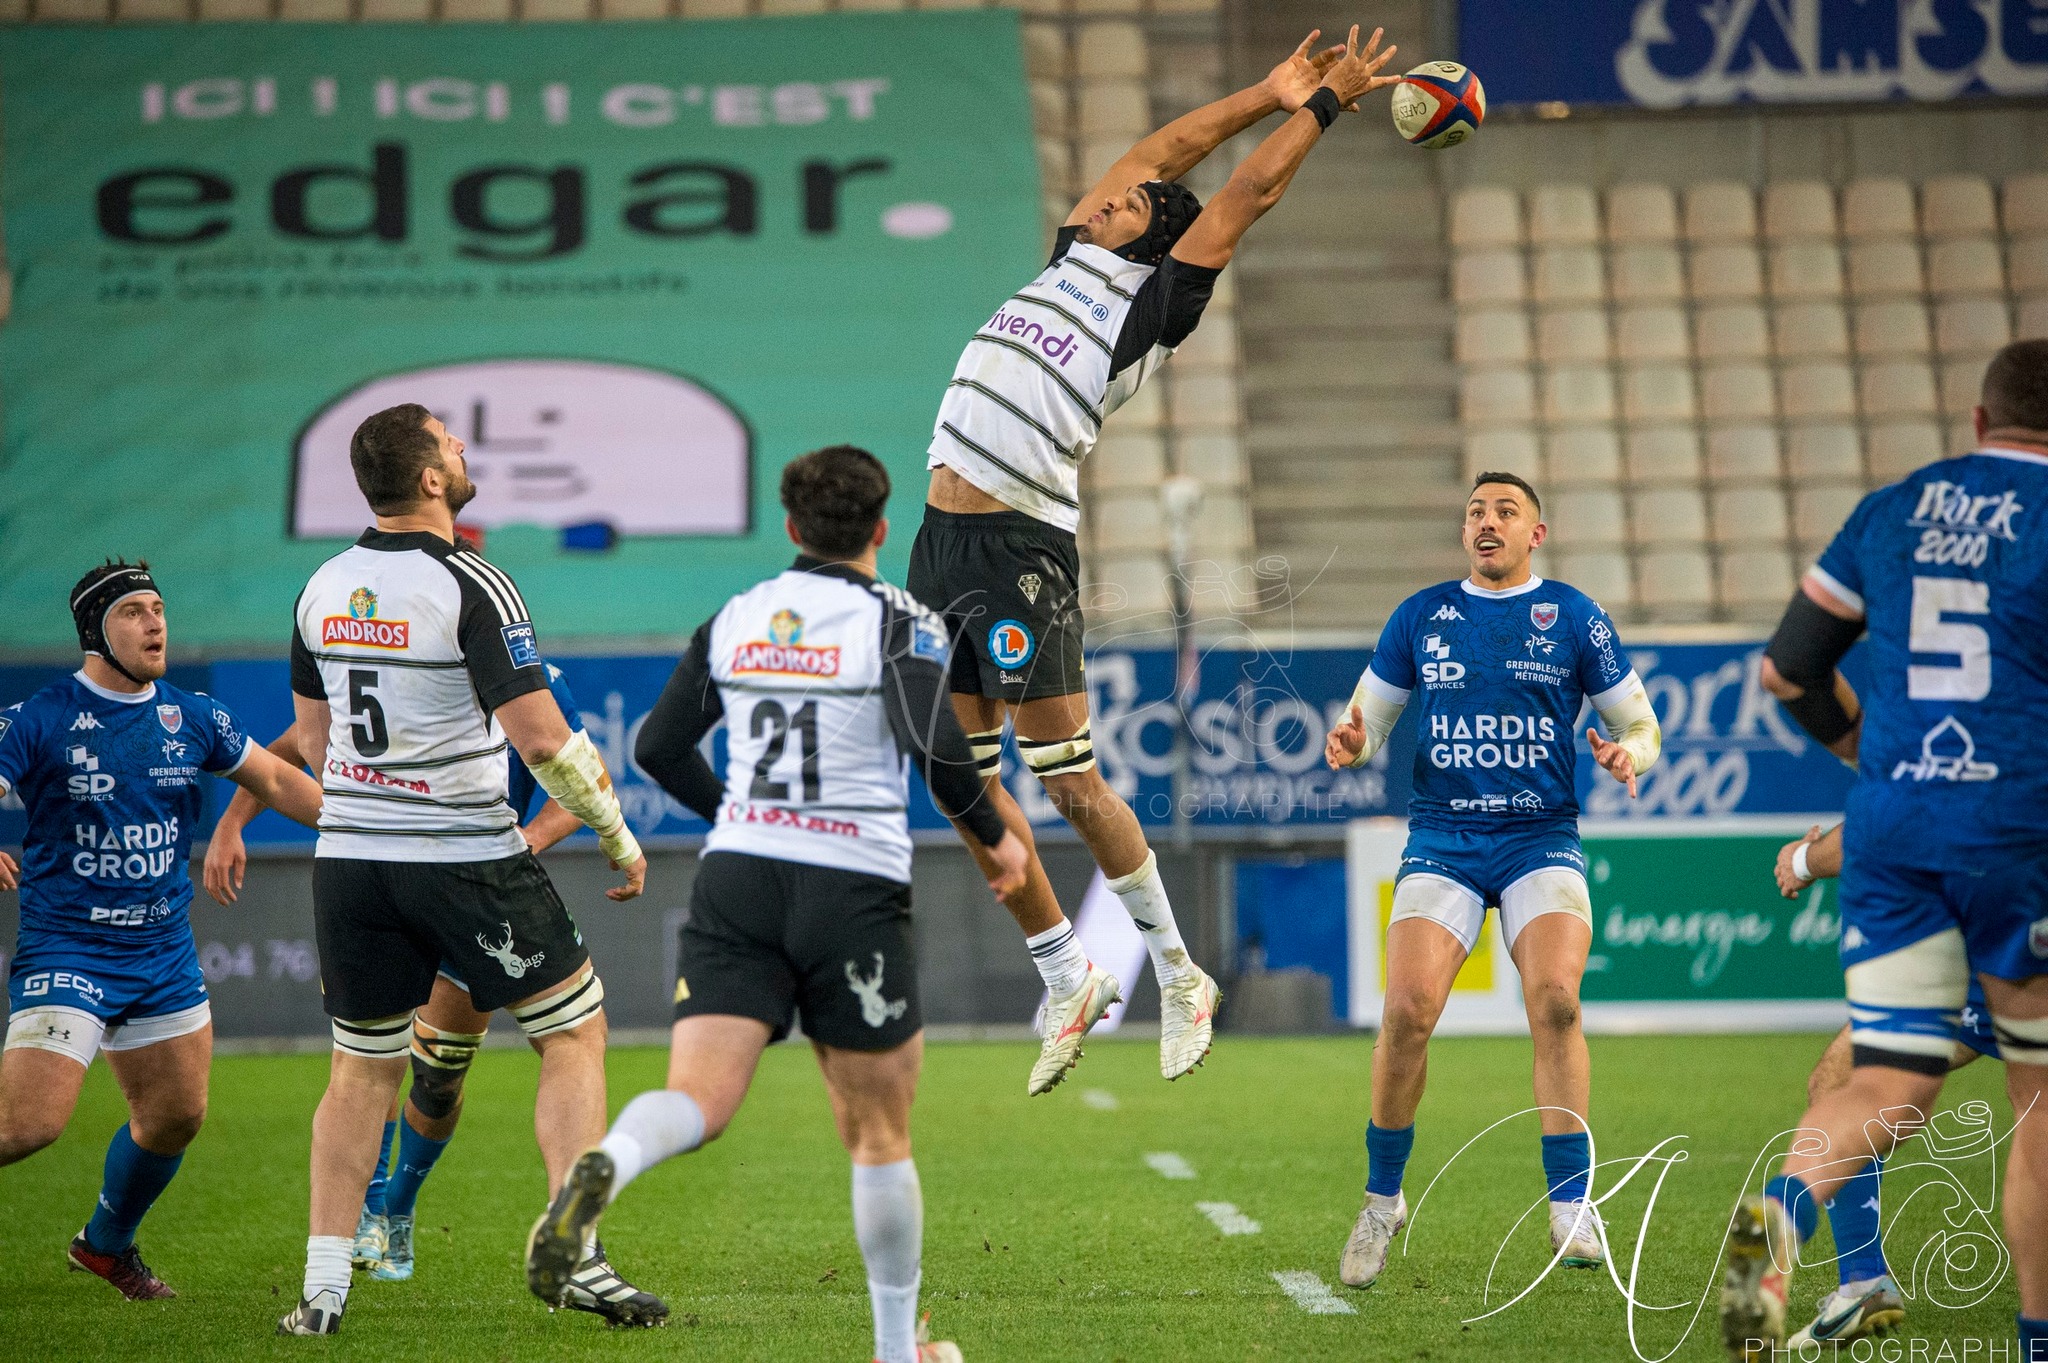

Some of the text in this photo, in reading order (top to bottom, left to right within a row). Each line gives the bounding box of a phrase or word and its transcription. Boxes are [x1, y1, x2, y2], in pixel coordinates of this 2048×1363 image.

[1055, 279, 1095, 308] Allianz
[988, 307, 1079, 368] ivendi
[1914, 528, 1990, 569] 2000
[325, 620, 406, 647] ANDROS
[507, 627, 532, 641] PRO
[1907, 575, 1992, 702] 5
[514, 646, 538, 662] D2
[734, 645, 838, 675] ANDROS
[1421, 662, 1466, 683] SD
[1515, 670, 1562, 687] MÉTROPOLE
[1426, 682, 1466, 691] SERVICES
[348, 669, 390, 758] 5
[1432, 715, 1555, 742] HARDIS
[749, 699, 820, 801] 21
[1430, 743, 1549, 769] GROUP
[67, 774, 116, 794] SD
[69, 793, 114, 802] SERVICES
[75, 817, 179, 850] HARDIS
[72, 848, 175, 880] GROUP
[510, 951, 545, 974] Stags
[53, 973, 104, 1001] ECM
